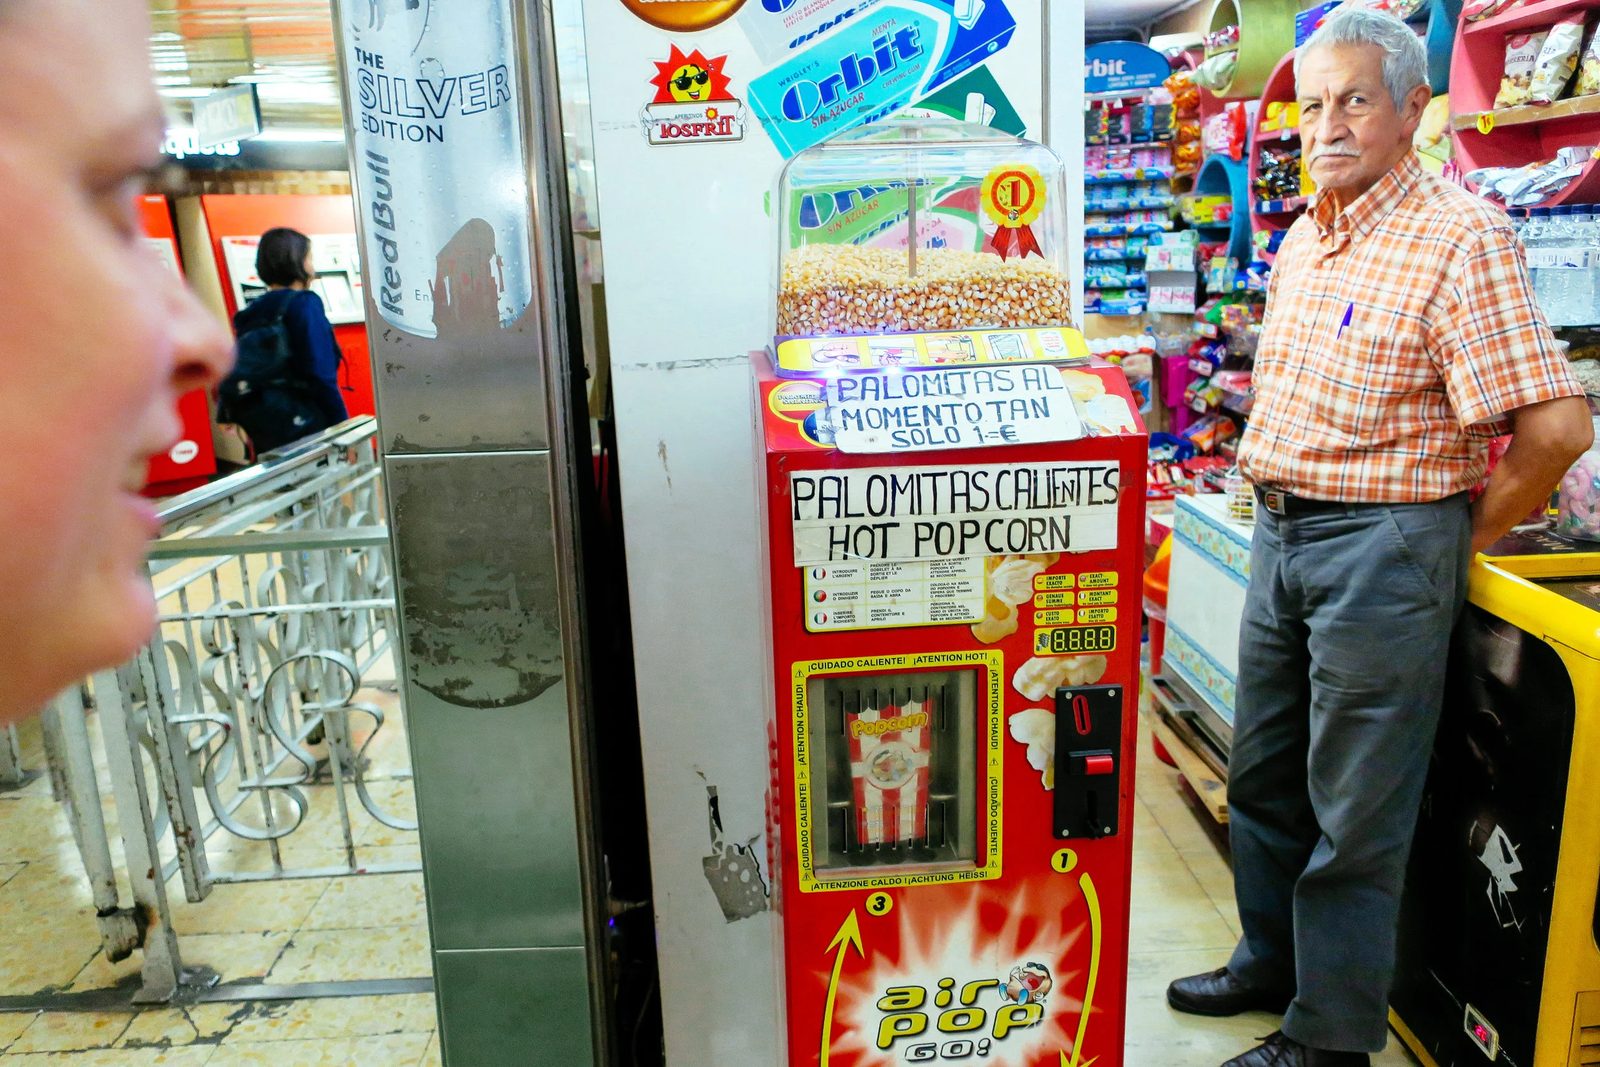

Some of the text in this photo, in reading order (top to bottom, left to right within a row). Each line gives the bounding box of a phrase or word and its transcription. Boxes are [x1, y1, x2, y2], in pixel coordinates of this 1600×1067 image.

[788, 7, 857, 49] Orbit
[871, 18, 897, 37] MENTA
[354, 46, 386, 70] THE
[777, 60, 821, 89] WRIGLEY'S
[781, 23, 925, 123] Orbit
[1084, 58, 1127, 78] rbit
[356, 63, 512, 120] SILVER
[881, 63, 922, 89] CHEWING GUM
[360, 112, 445, 143] EDITION
[811, 92, 866, 129] SIN AZUCAR
[364, 149, 405, 317] Red Bull
[826, 199, 881, 236] SIN AZUCAR
[837, 366, 1064, 402] PALOMITAS AL
[842, 401, 983, 433] MOMENTO
[985, 396, 1050, 422] TAN
[891, 425, 961, 449] SOLO
[792, 465, 1120, 522] PALOMITAS CALIENTES
[829, 512, 1072, 562] HOT POPCORN
[808, 657, 906, 673] ¡CUIDADO CALIENTE!
[913, 652, 988, 666] ¡ATENTION HOT!
[795, 684, 804, 719] CHAUD!
[990, 669, 999, 750] ¡ATENTION CHAUD!
[850, 712, 929, 740] Popcorn
[799, 783, 808, 828] CALIENTE!
[989, 776, 998, 856] ¡CUIDADO QUENTE!
[1060, 852, 1068, 870] 1
[811, 880, 869, 891] ¡ATTENZIONE
[958, 870, 988, 880] HEISS!
[872, 896, 886, 912] 3
[876, 976, 1000, 1012] air
[876, 1002, 1044, 1050] pop
[904, 1037, 992, 1063] GO!
